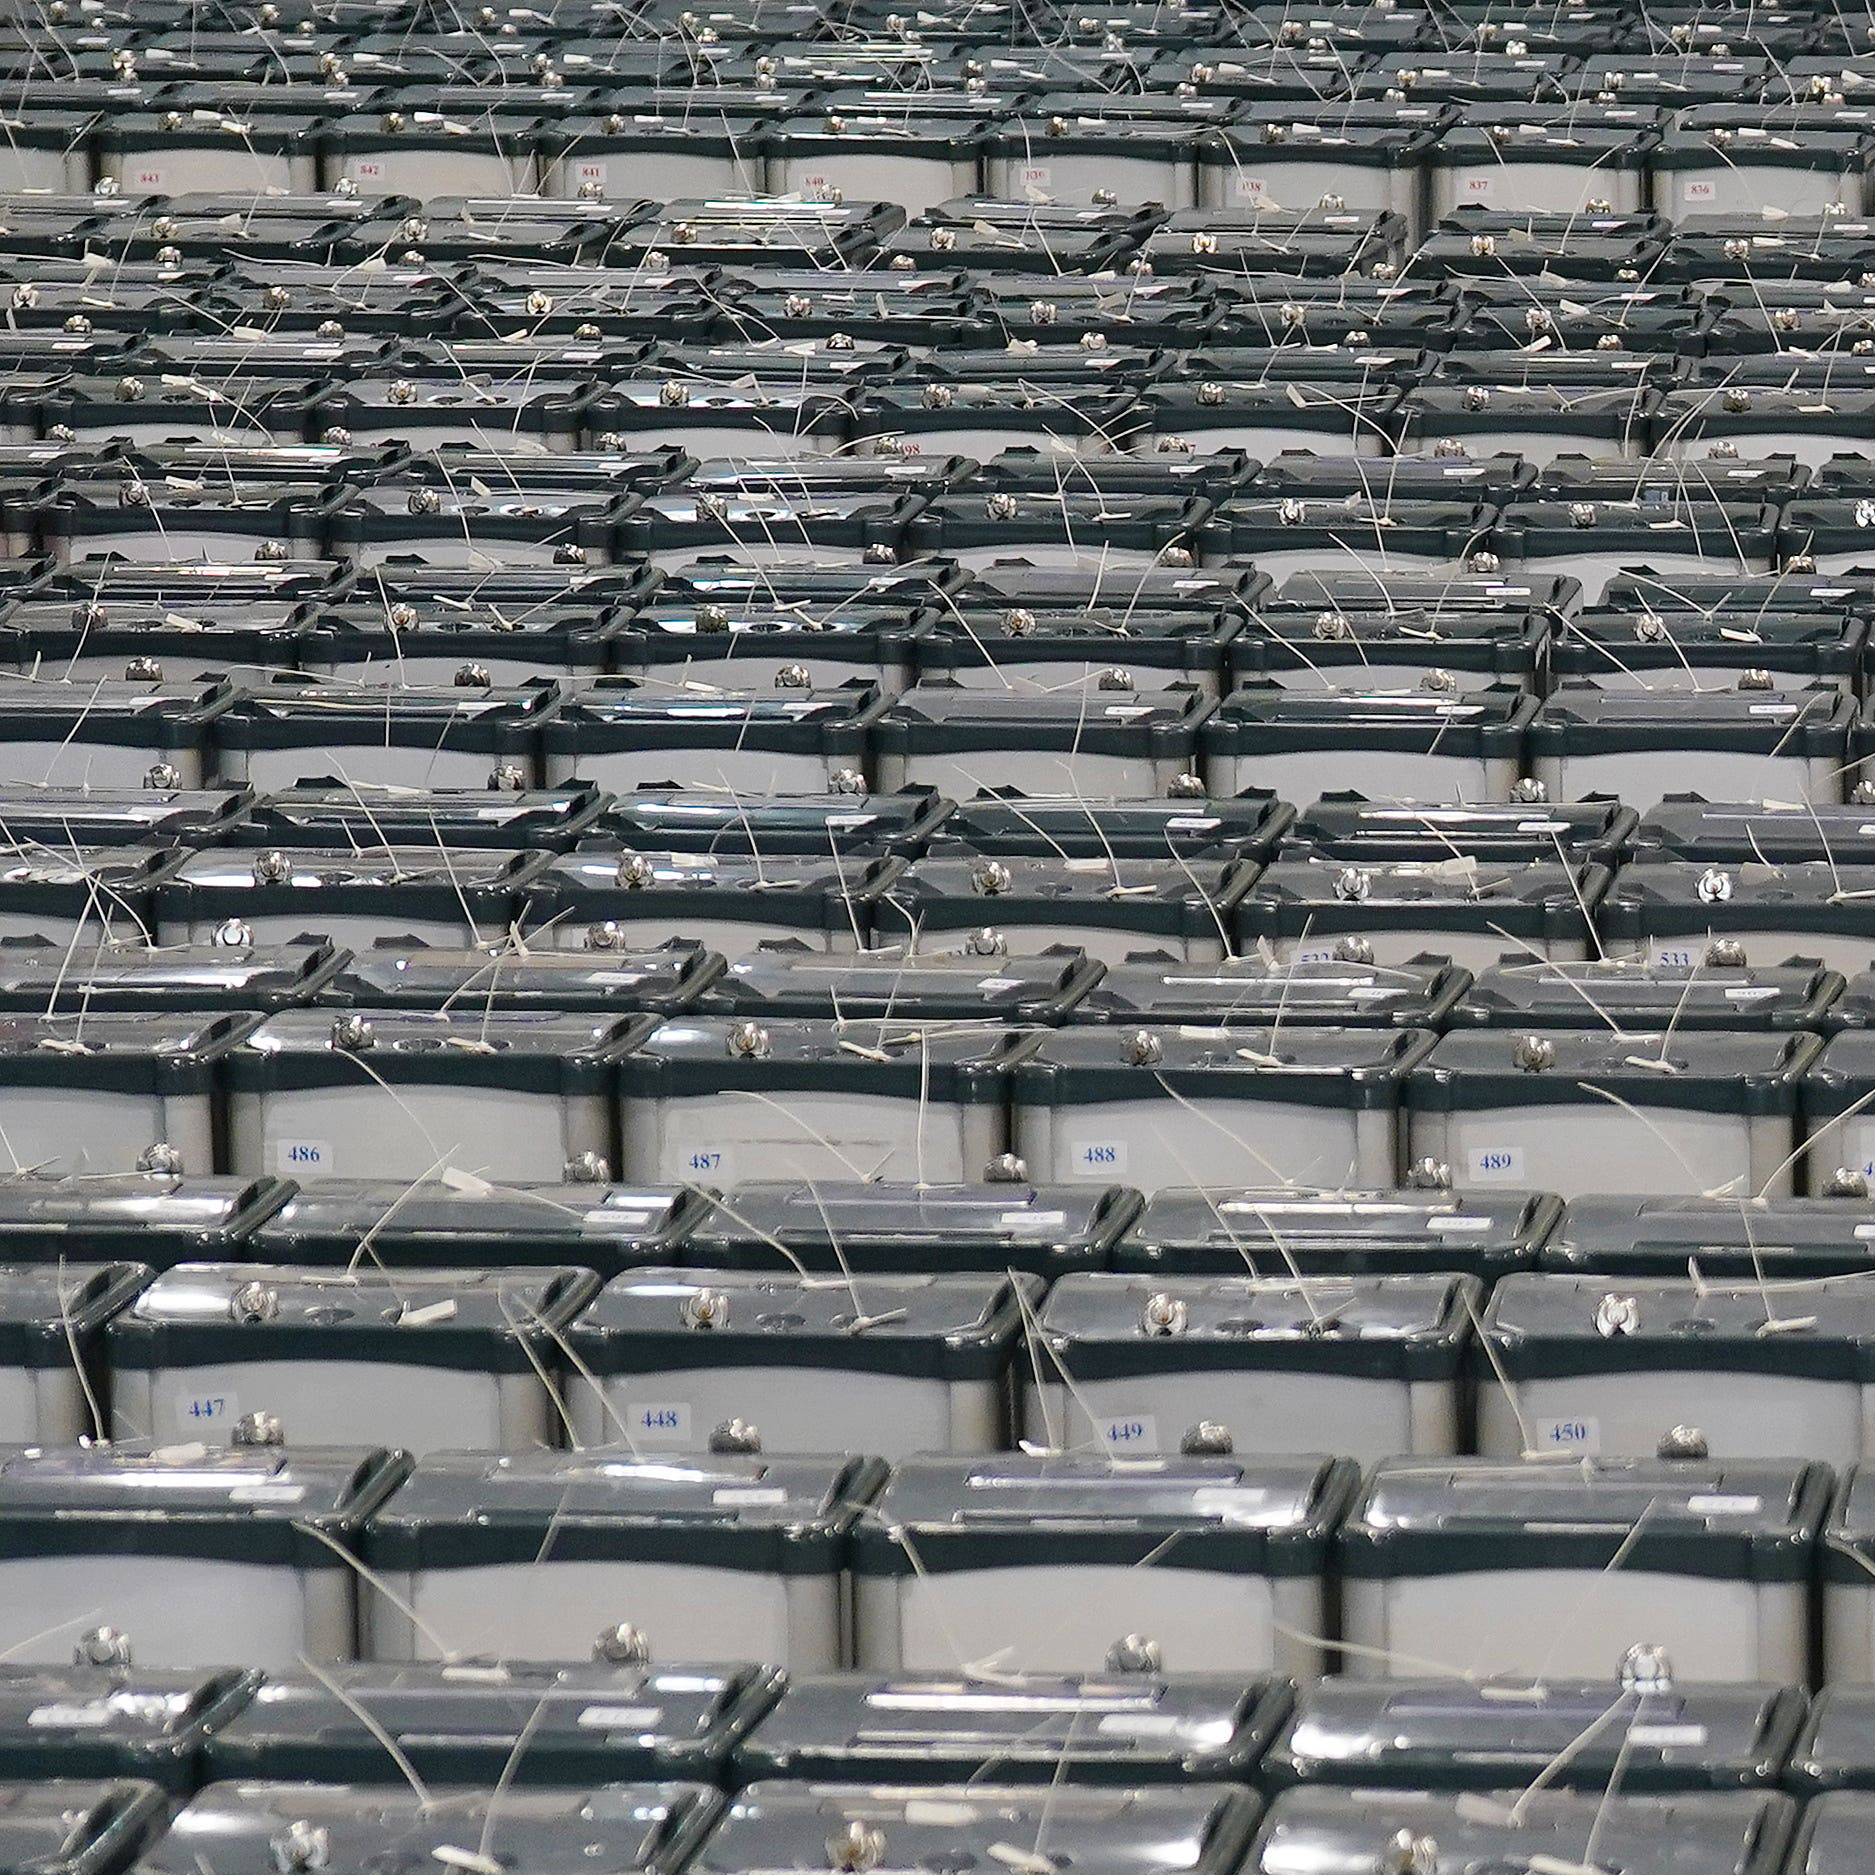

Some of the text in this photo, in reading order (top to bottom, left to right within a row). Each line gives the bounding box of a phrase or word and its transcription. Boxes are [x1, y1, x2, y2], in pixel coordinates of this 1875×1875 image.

[1659, 951, 1689, 967] 533
[287, 1145, 322, 1163] 486
[689, 1152, 722, 1171] 487
[1083, 1146, 1117, 1164] 488
[1479, 1153, 1513, 1171] 489
[188, 1397, 225, 1419] 447
[640, 1410, 679, 1429] 448
[1110, 1423, 1145, 1443] 449
[1550, 1422, 1588, 1443] 450
